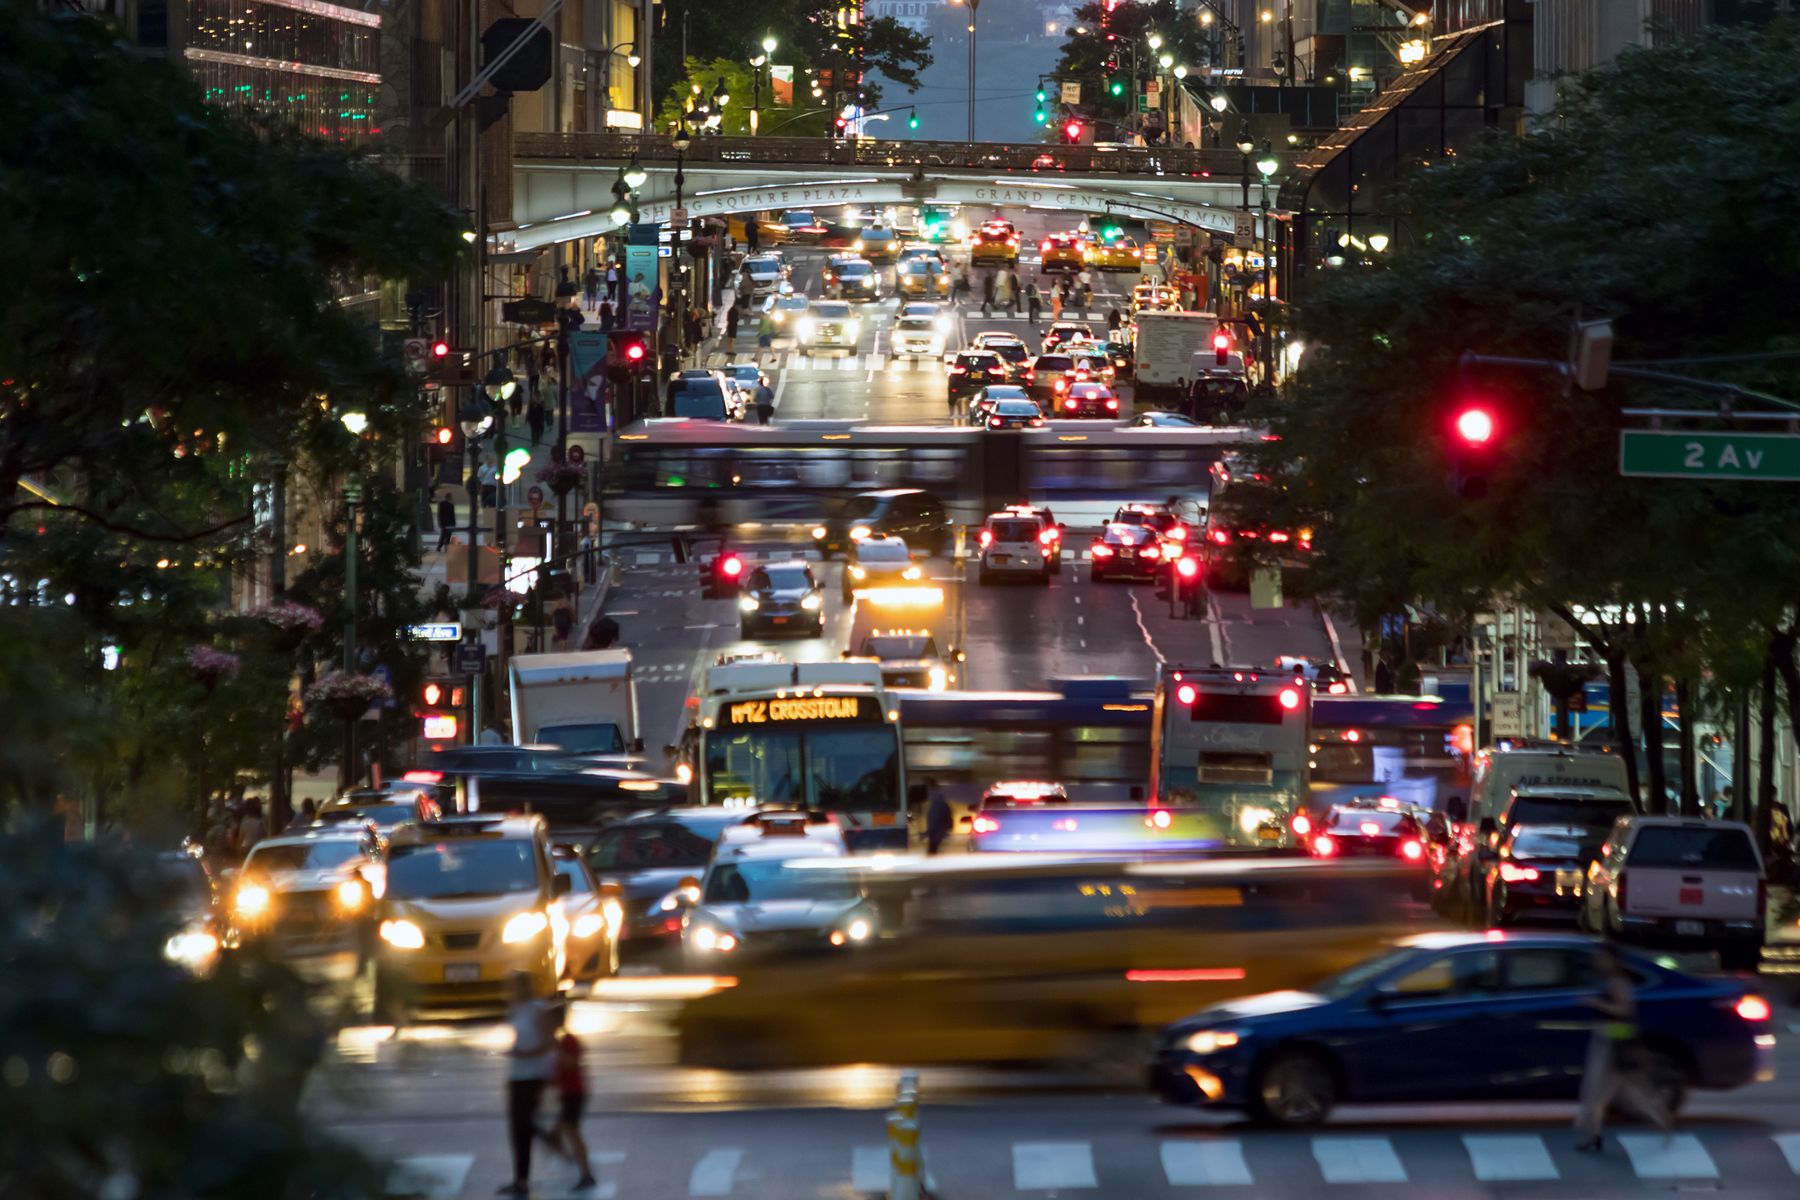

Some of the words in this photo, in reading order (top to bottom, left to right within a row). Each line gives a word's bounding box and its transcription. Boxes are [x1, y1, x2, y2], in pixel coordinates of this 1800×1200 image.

[716, 192, 789, 209] SQUARE
[804, 188, 863, 200] PLAZA
[976, 188, 1042, 202] GRAND
[1056, 193, 1143, 212] CENTRAL
[1158, 204, 1233, 226] TERMIN
[1237, 226, 1250, 237] 25
[1684, 442, 1705, 468] 2
[1718, 444, 1763, 470] Av
[769, 697, 858, 720] CROSSTOWN
[1519, 775, 1541, 786] AIR
